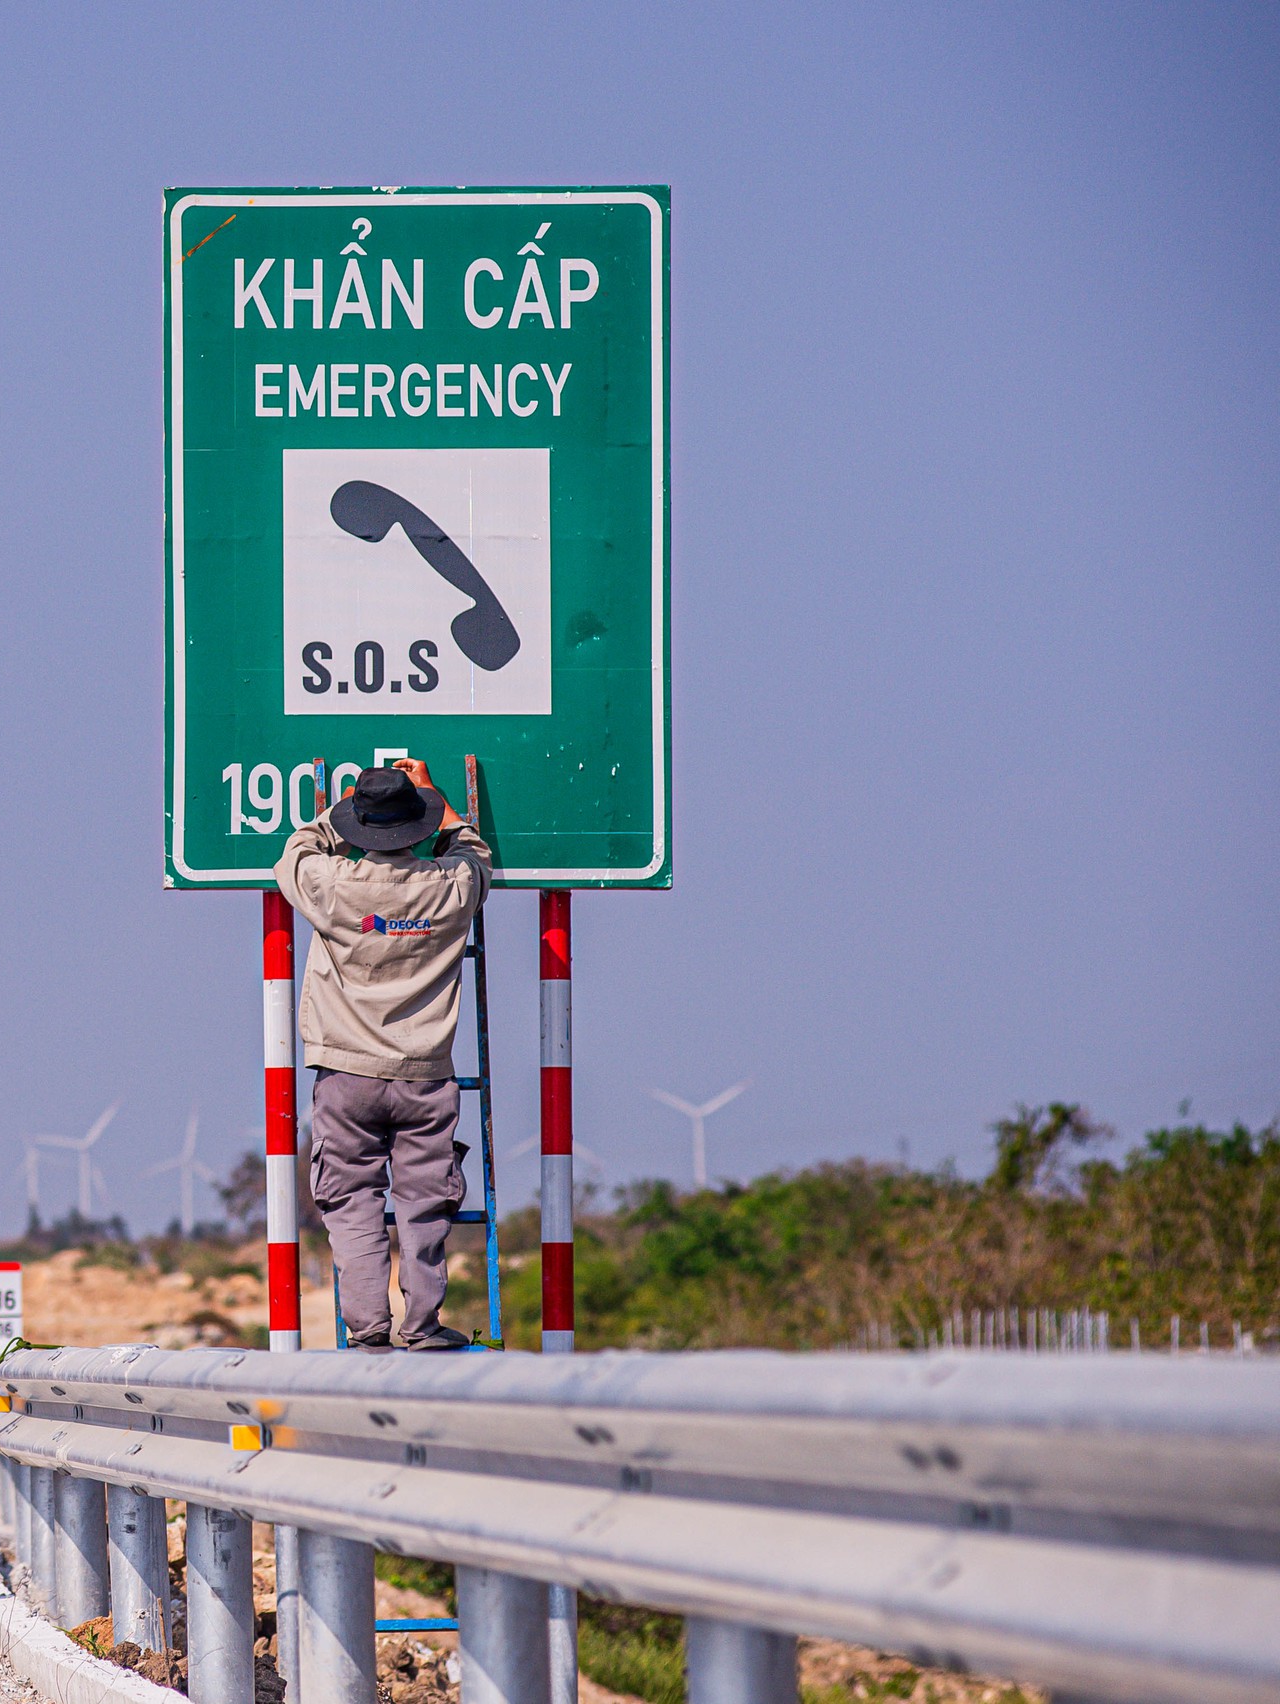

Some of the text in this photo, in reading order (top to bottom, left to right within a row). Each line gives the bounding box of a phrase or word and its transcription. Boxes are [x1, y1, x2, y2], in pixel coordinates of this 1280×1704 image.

[234, 217, 600, 330] KHẨN CẤP
[255, 363, 573, 418] EMERGENCY
[301, 640, 439, 695] S.O.S
[388, 918, 431, 930] DEOCA
